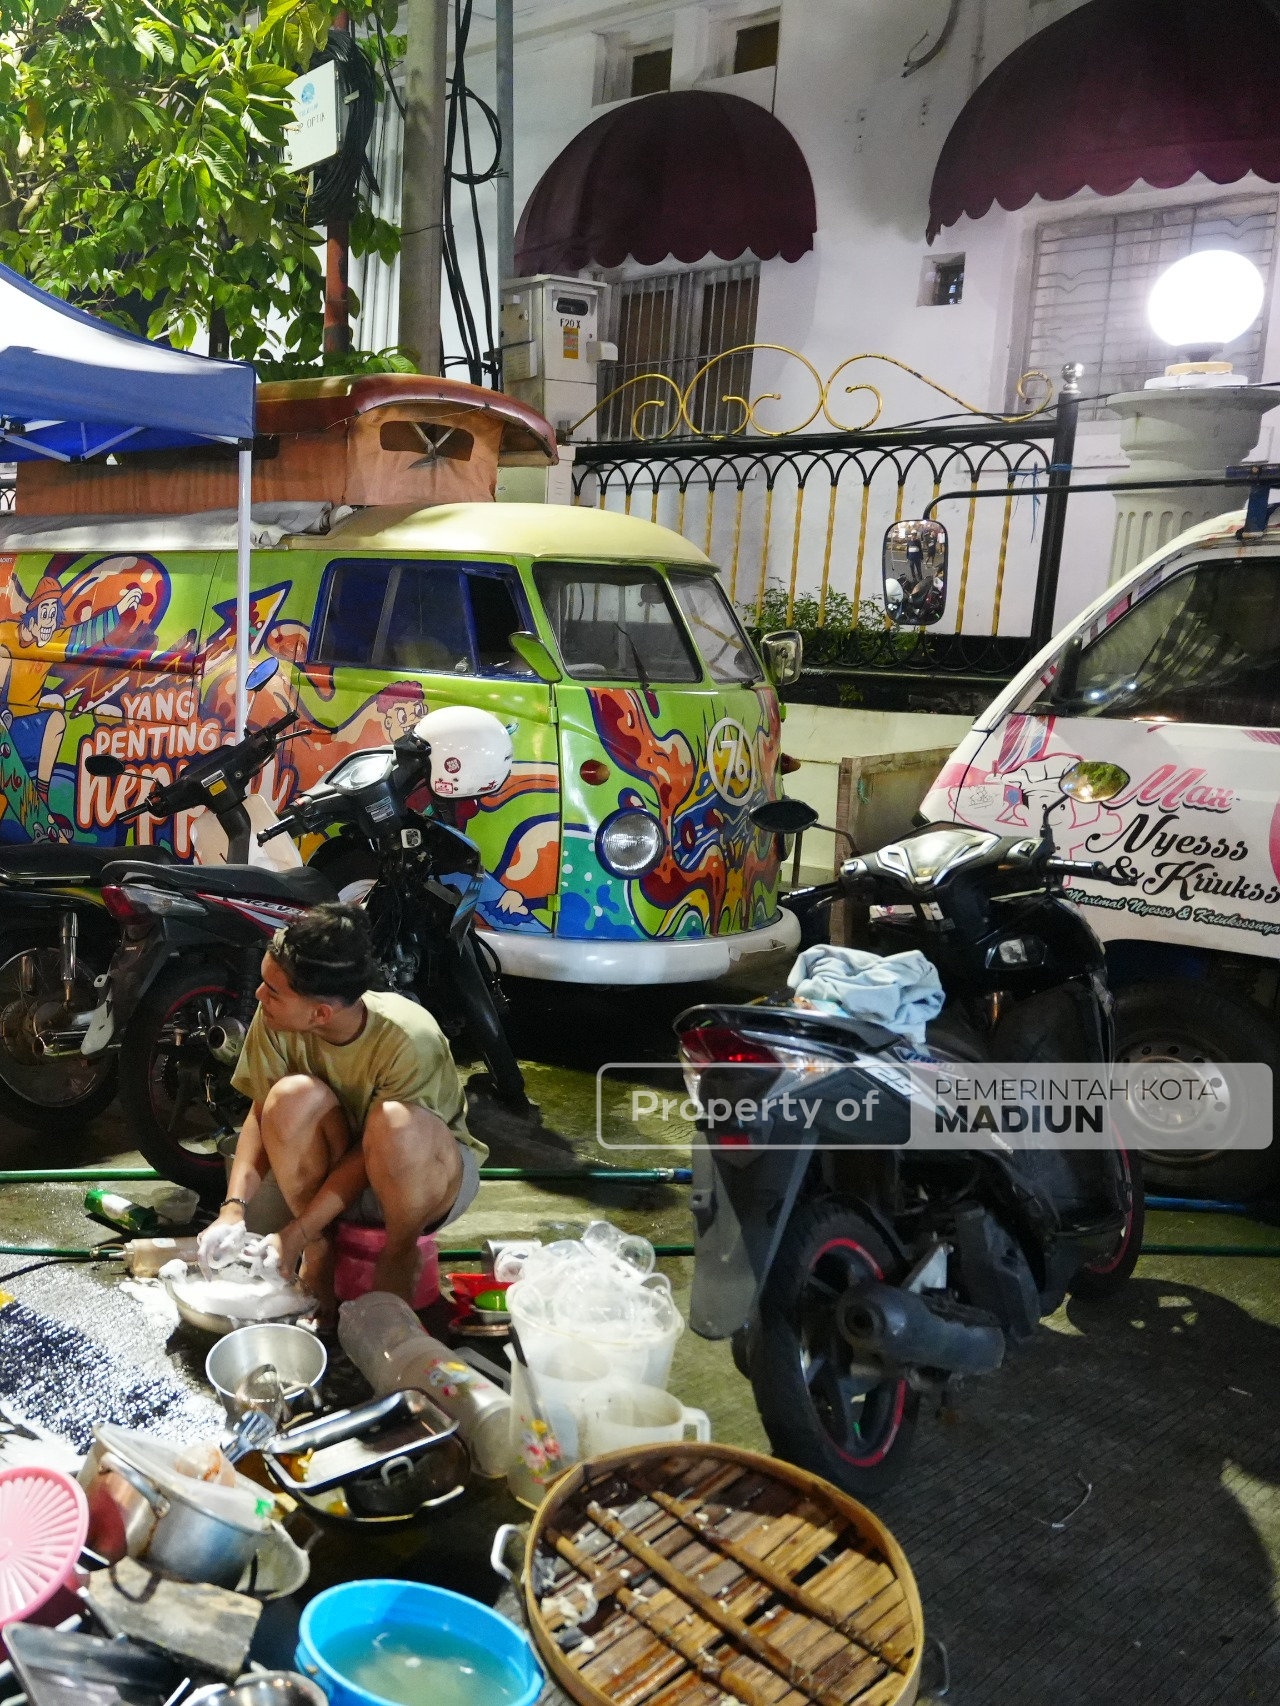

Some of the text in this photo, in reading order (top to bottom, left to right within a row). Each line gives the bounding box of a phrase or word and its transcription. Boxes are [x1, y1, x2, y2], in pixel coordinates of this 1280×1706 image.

[124, 690, 195, 724] YANG
[95, 722, 219, 757] PENTING
[720, 732, 748, 793] 76
[1103, 764, 1234, 813] Max
[1085, 814, 1248, 861] Nyesss
[1106, 856, 1145, 883] &
[1065, 888, 1126, 909] Maximal
[1128, 899, 1174, 916] Nyesss
[1177, 906, 1191, 919] &
